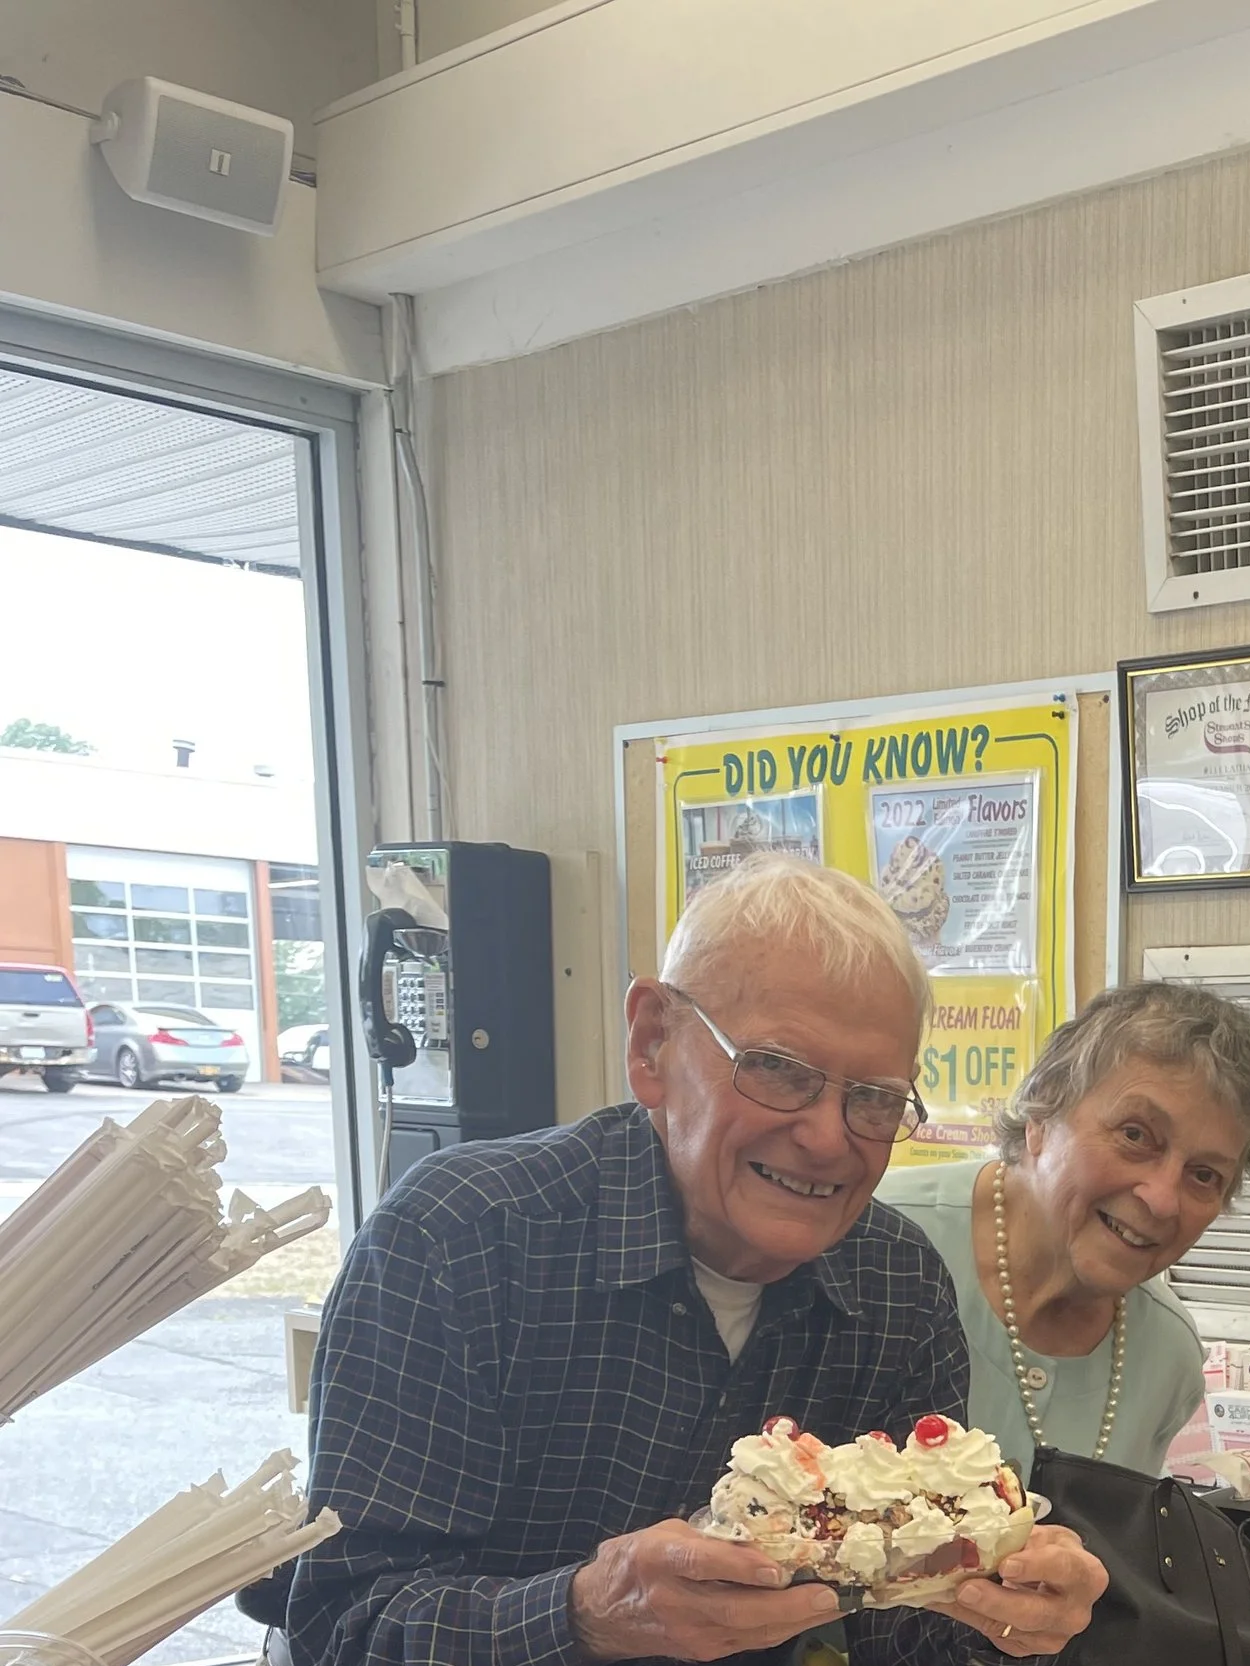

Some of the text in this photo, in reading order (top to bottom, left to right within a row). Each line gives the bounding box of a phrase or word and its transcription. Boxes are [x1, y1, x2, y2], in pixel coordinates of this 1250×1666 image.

[1165, 702, 1206, 739] Shop
[1209, 695, 1220, 713] of
[1224, 694, 1241, 712] the
[723, 724, 990, 797] DID YOU KNOW?
[881, 794, 1027, 828] 2022 Flavors
[689, 853, 741, 870] ICED COFFEE
[923, 1044, 1016, 1101] $1 OFF
[916, 1126, 932, 1140] Ice
[936, 1125, 969, 1141] Cream
